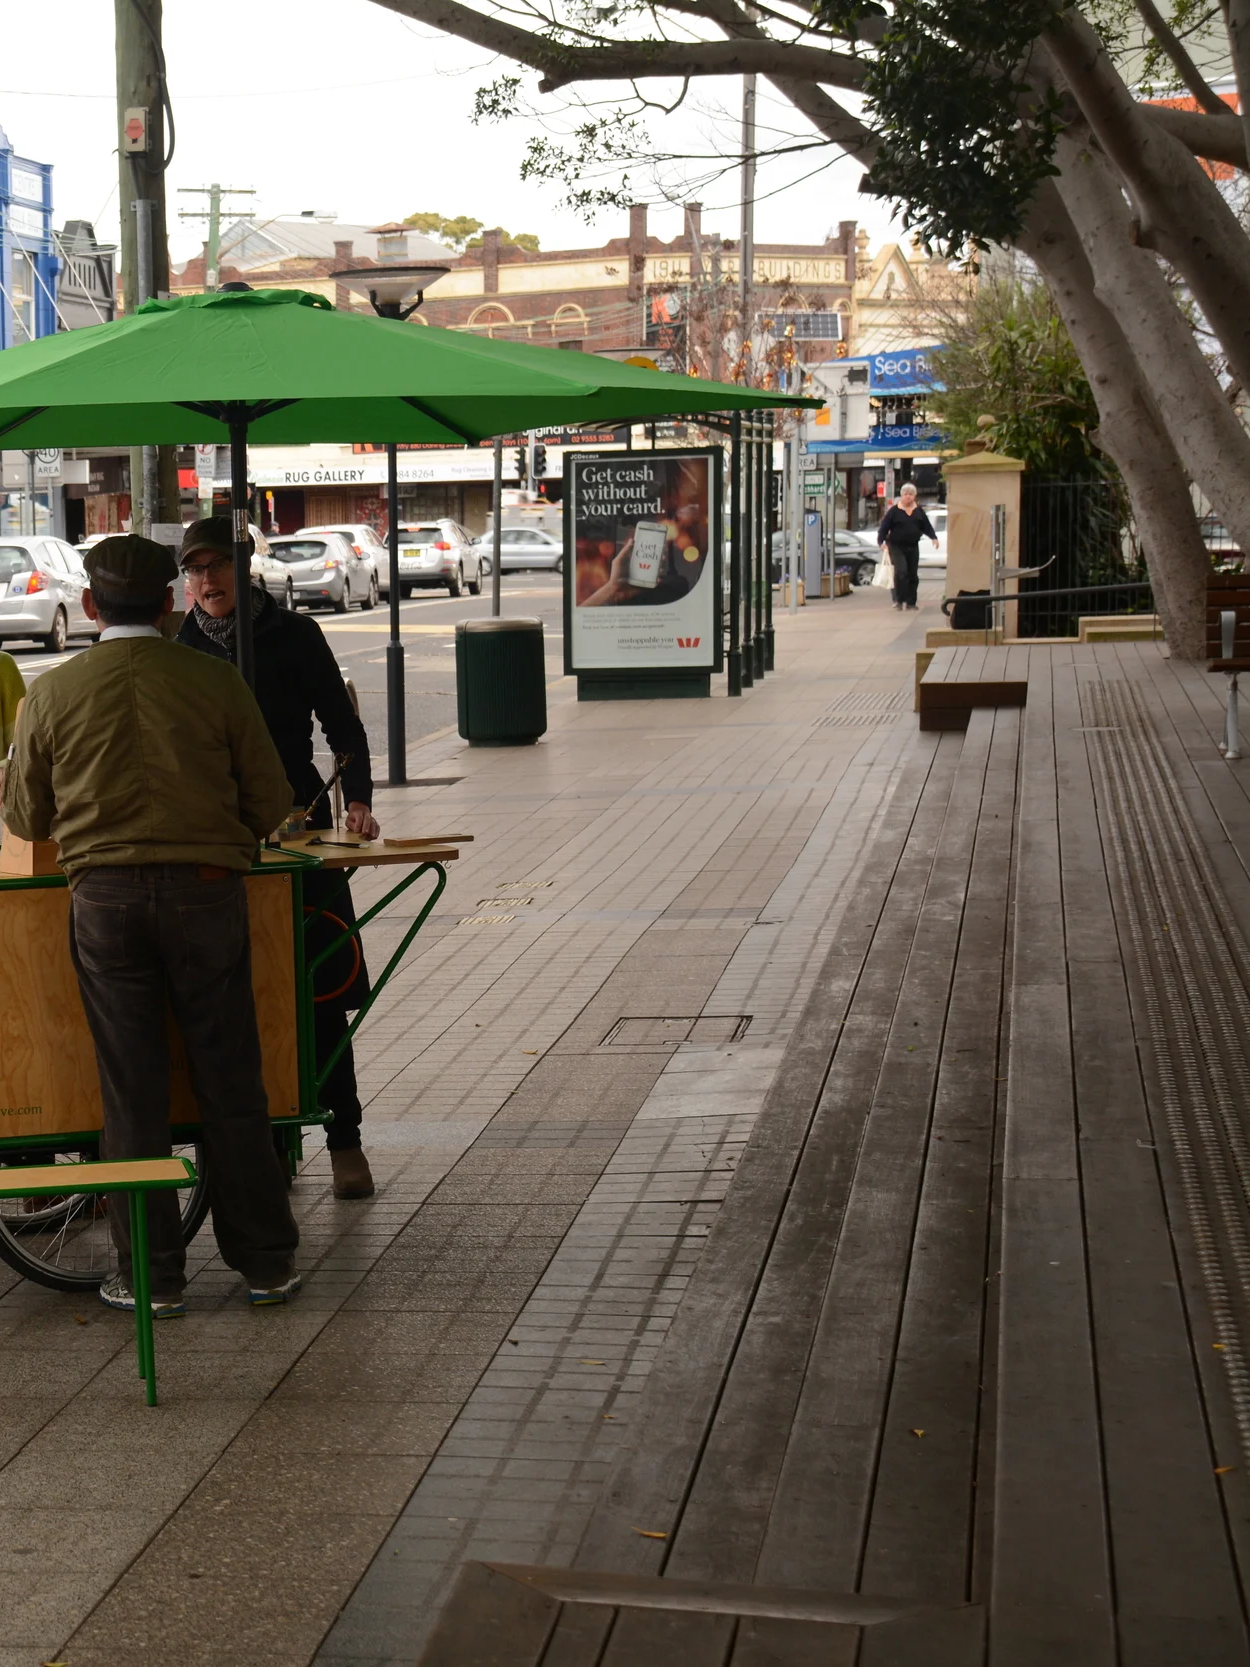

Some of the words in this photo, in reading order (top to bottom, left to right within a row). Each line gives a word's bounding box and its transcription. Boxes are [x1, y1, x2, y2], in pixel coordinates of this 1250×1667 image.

[875, 355, 910, 375] Sea
[885, 425, 910, 438] Sea
[571, 436, 580, 444] 02
[37, 466, 60, 474] AREA
[285, 472, 309, 483] RUG
[314, 470, 365, 483] GALLERY
[411, 469, 435, 479] 8264
[582, 466, 613, 484] Get
[616, 465, 654, 483] cash
[582, 483, 648, 501] without
[578, 503, 622, 521] your
[623, 498, 666, 516] card.
[617, 636, 659, 645] unstoppable
[661, 637, 674, 645] you
